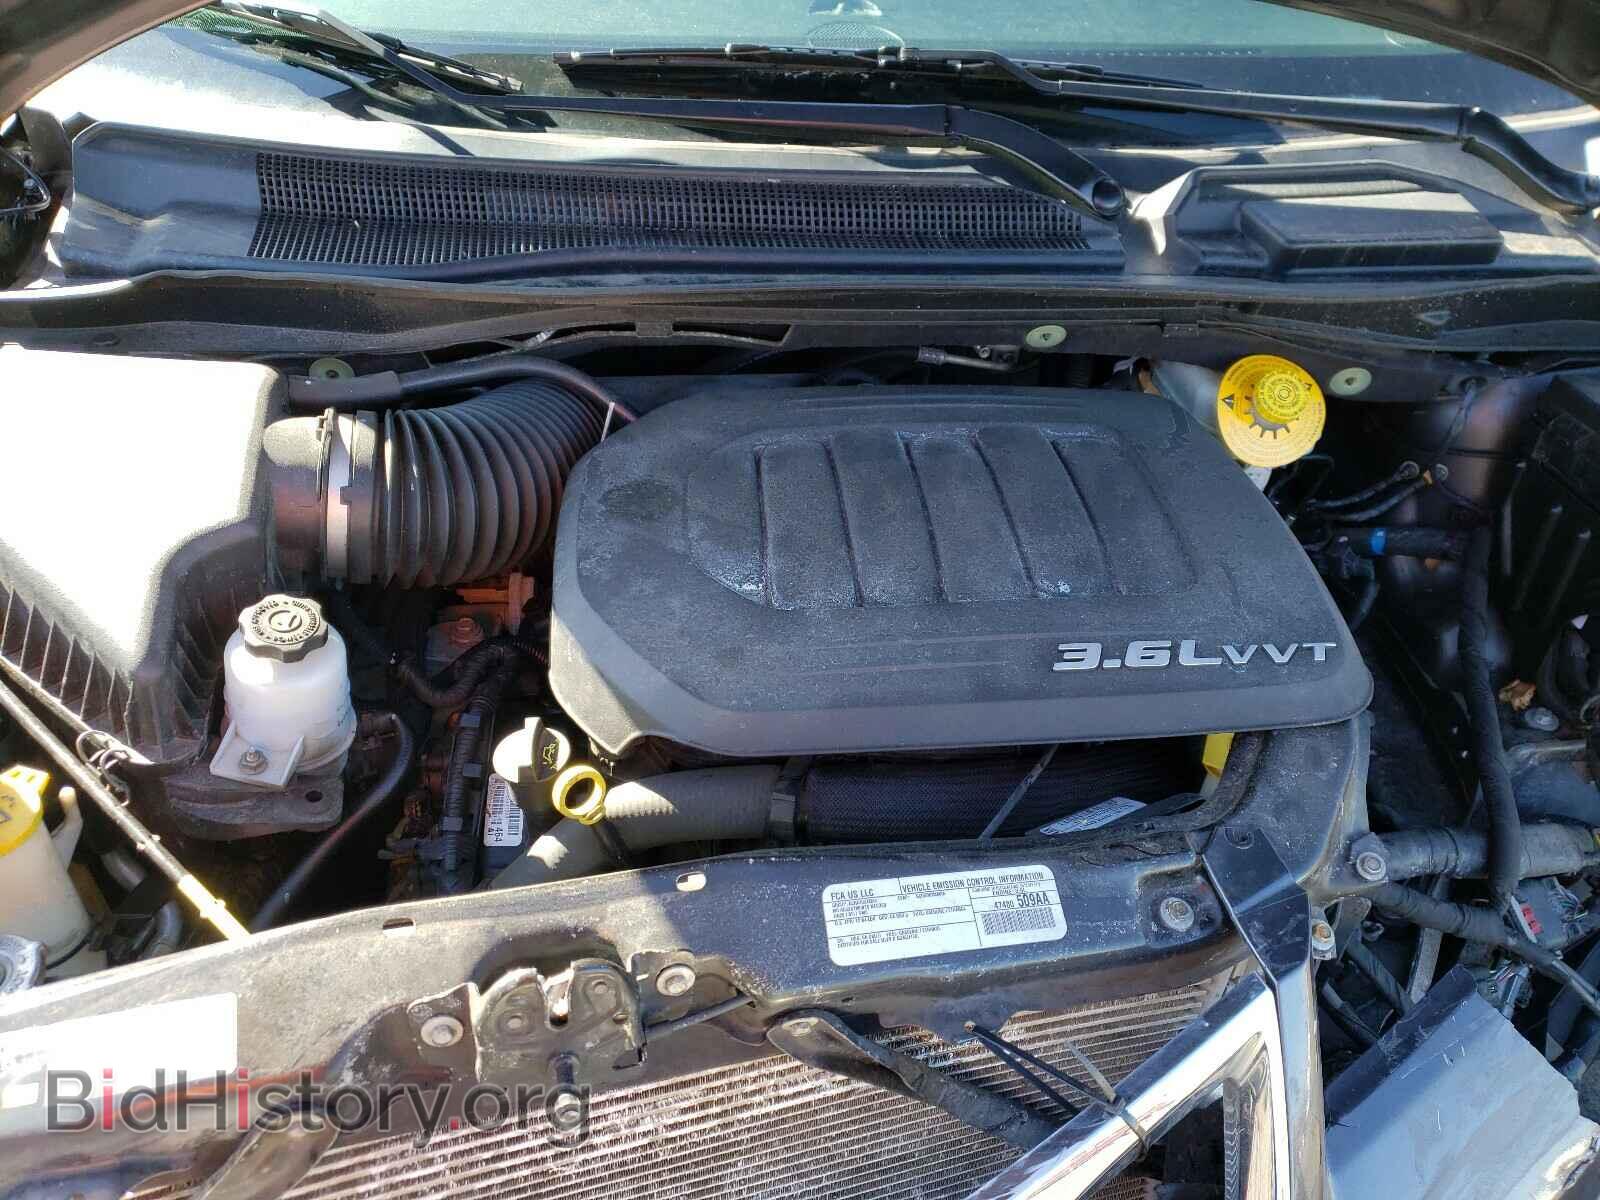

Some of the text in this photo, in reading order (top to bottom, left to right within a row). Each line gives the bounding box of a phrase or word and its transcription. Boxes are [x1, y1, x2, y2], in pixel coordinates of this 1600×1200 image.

[1052, 639, 1337, 672] 3.6L VVT
[902, 881, 931, 893] VEHICLE
[933, 879, 965, 890] EMISSION
[967, 876, 997, 887] CONTROL
[999, 871, 1044, 884] INFORMATION
[831, 888, 874, 901] FCA US LLC
[1016, 892, 1050, 908] 509AA
